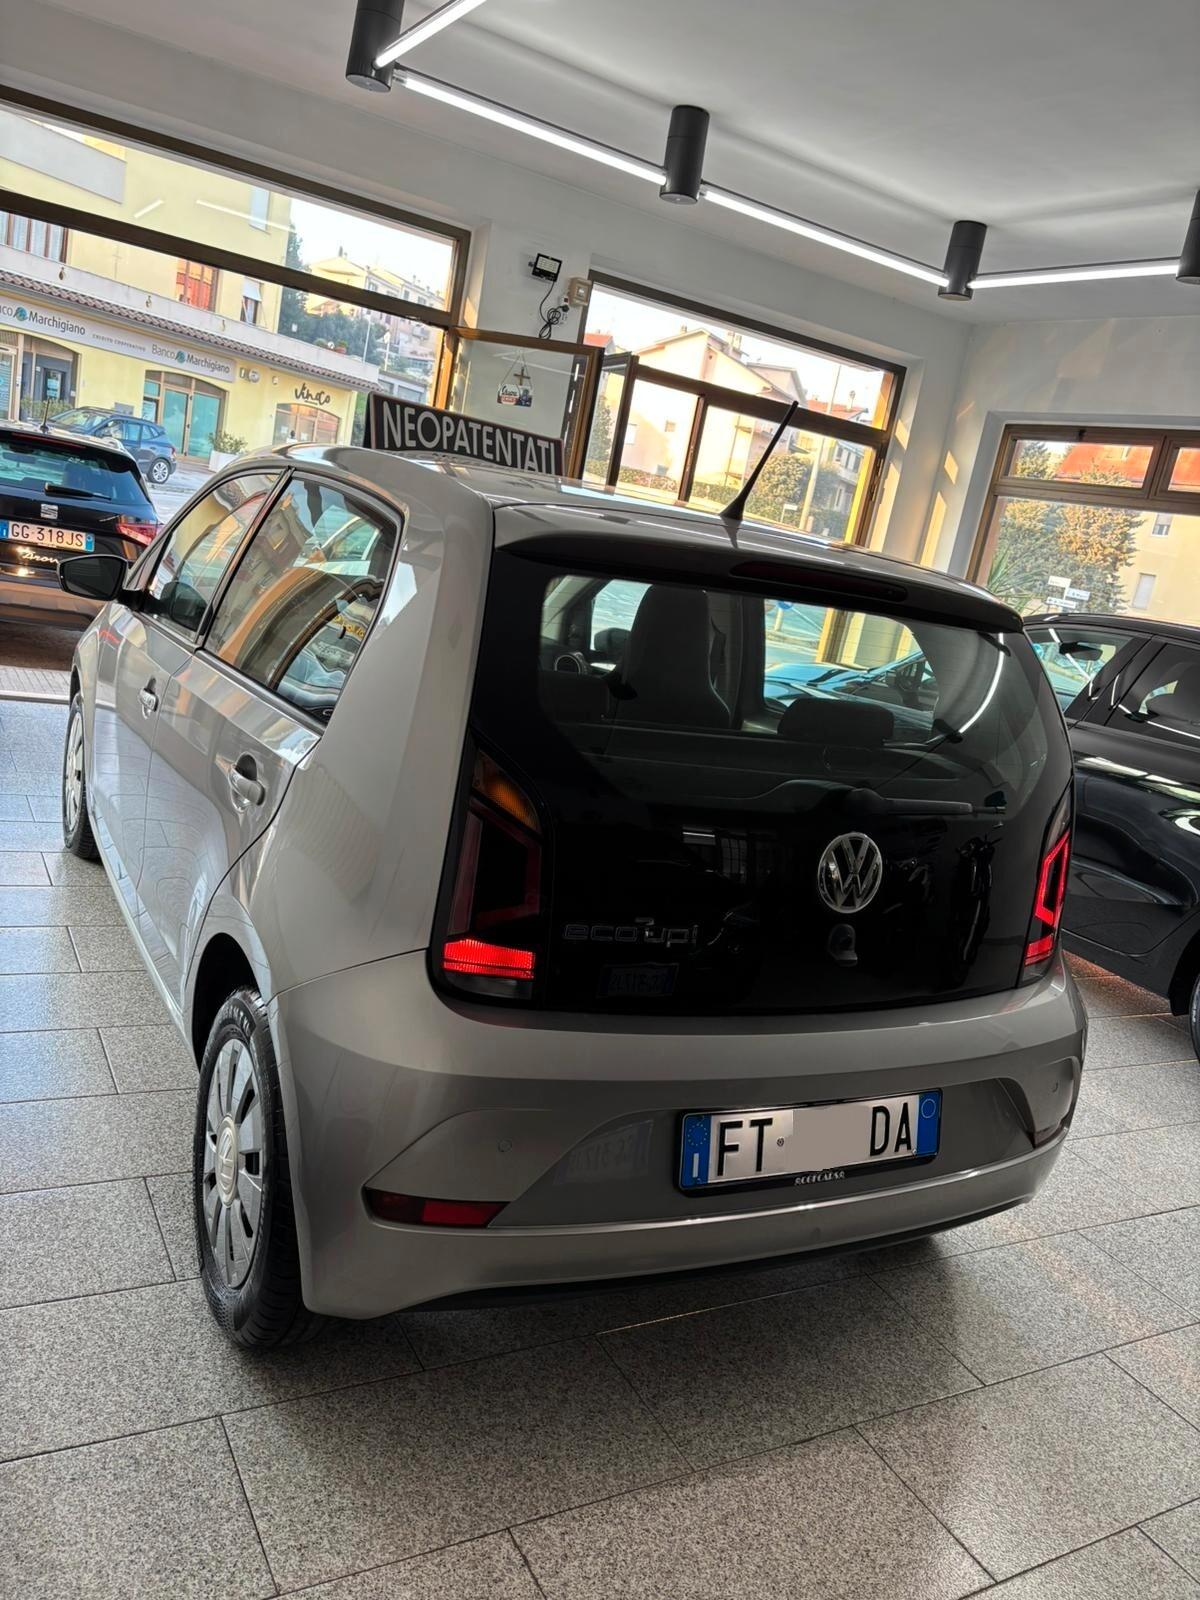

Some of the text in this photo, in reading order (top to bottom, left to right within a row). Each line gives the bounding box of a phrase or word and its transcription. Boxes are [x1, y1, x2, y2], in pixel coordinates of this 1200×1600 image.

[28, 310, 86, 336] Marchigiano
[151, 343, 231, 374] Banco Marchigiano
[382, 400, 556, 477] NEOPATENTATI
[11, 523, 30, 539] GG
[23, 552, 59, 563] Aron
[717, 1117, 774, 1177] FT
[869, 1101, 913, 1157] DA
